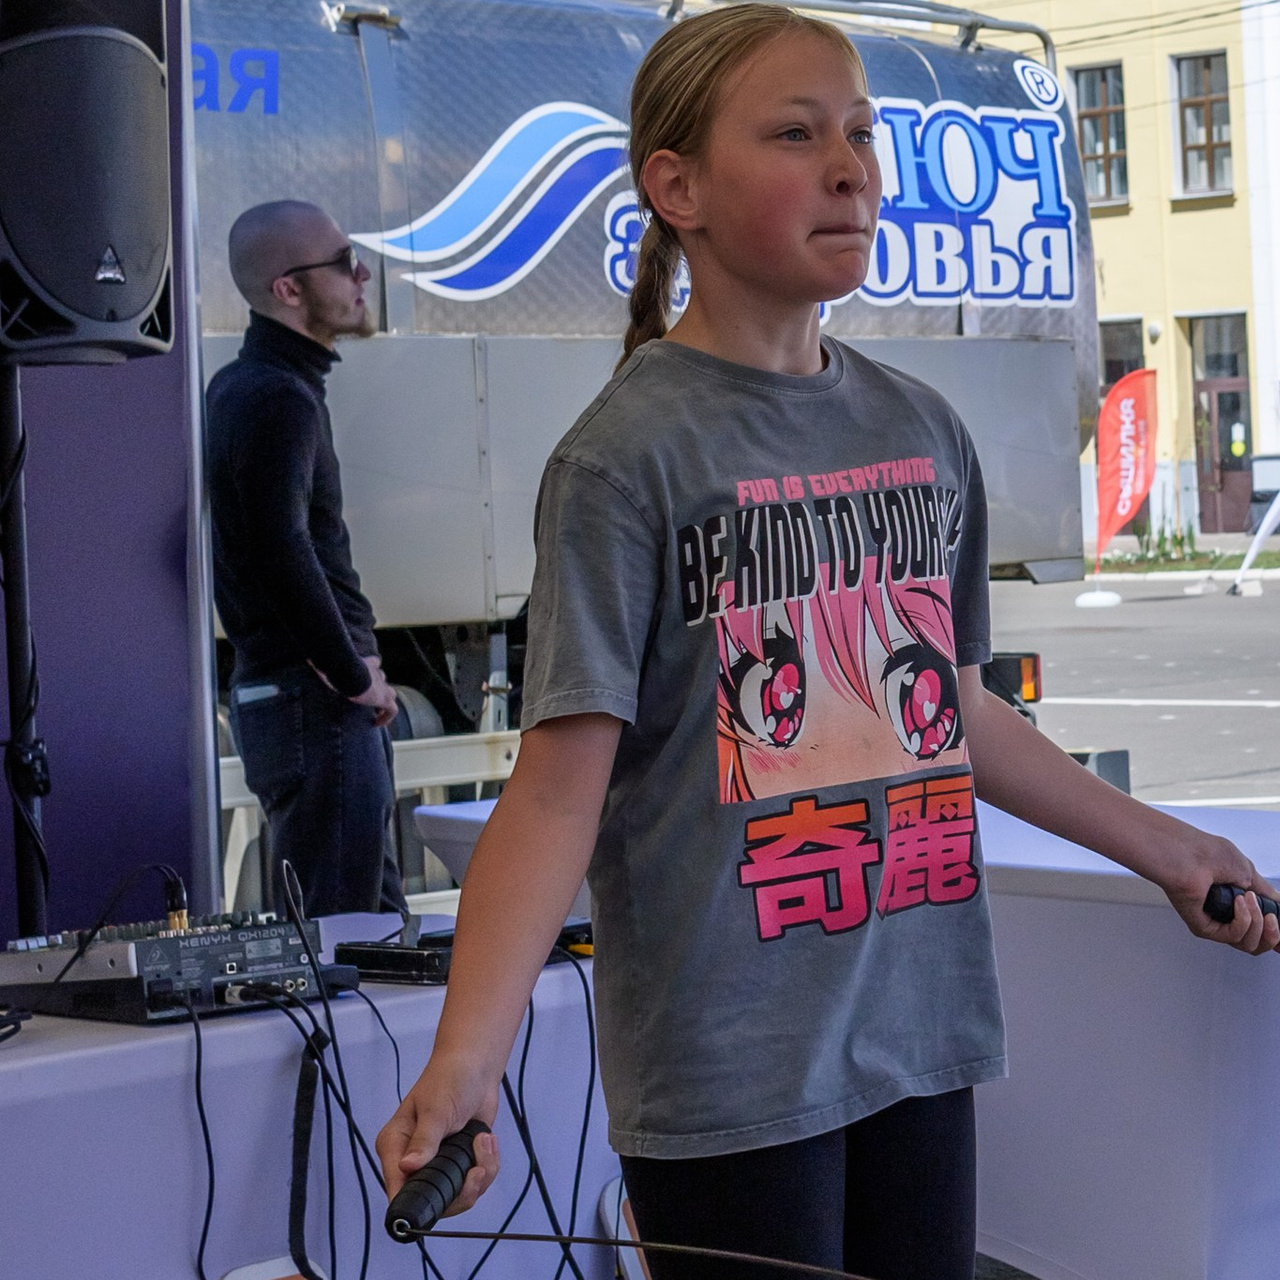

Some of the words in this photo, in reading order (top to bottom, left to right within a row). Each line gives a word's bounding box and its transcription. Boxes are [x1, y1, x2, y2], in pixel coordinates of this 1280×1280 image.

[873, 108, 1061, 220] ЮЧ
[736, 478, 779, 506] FUN
[783, 476, 805, 500] IS
[807, 457, 937, 496] EVERYTHING
[677, 516, 728, 626] BE
[734, 502, 819, 613] KIND
[813, 496, 865, 595] TO
[738, 772, 980, 942] 奇麗
[179, 933, 232, 948] XENYX
